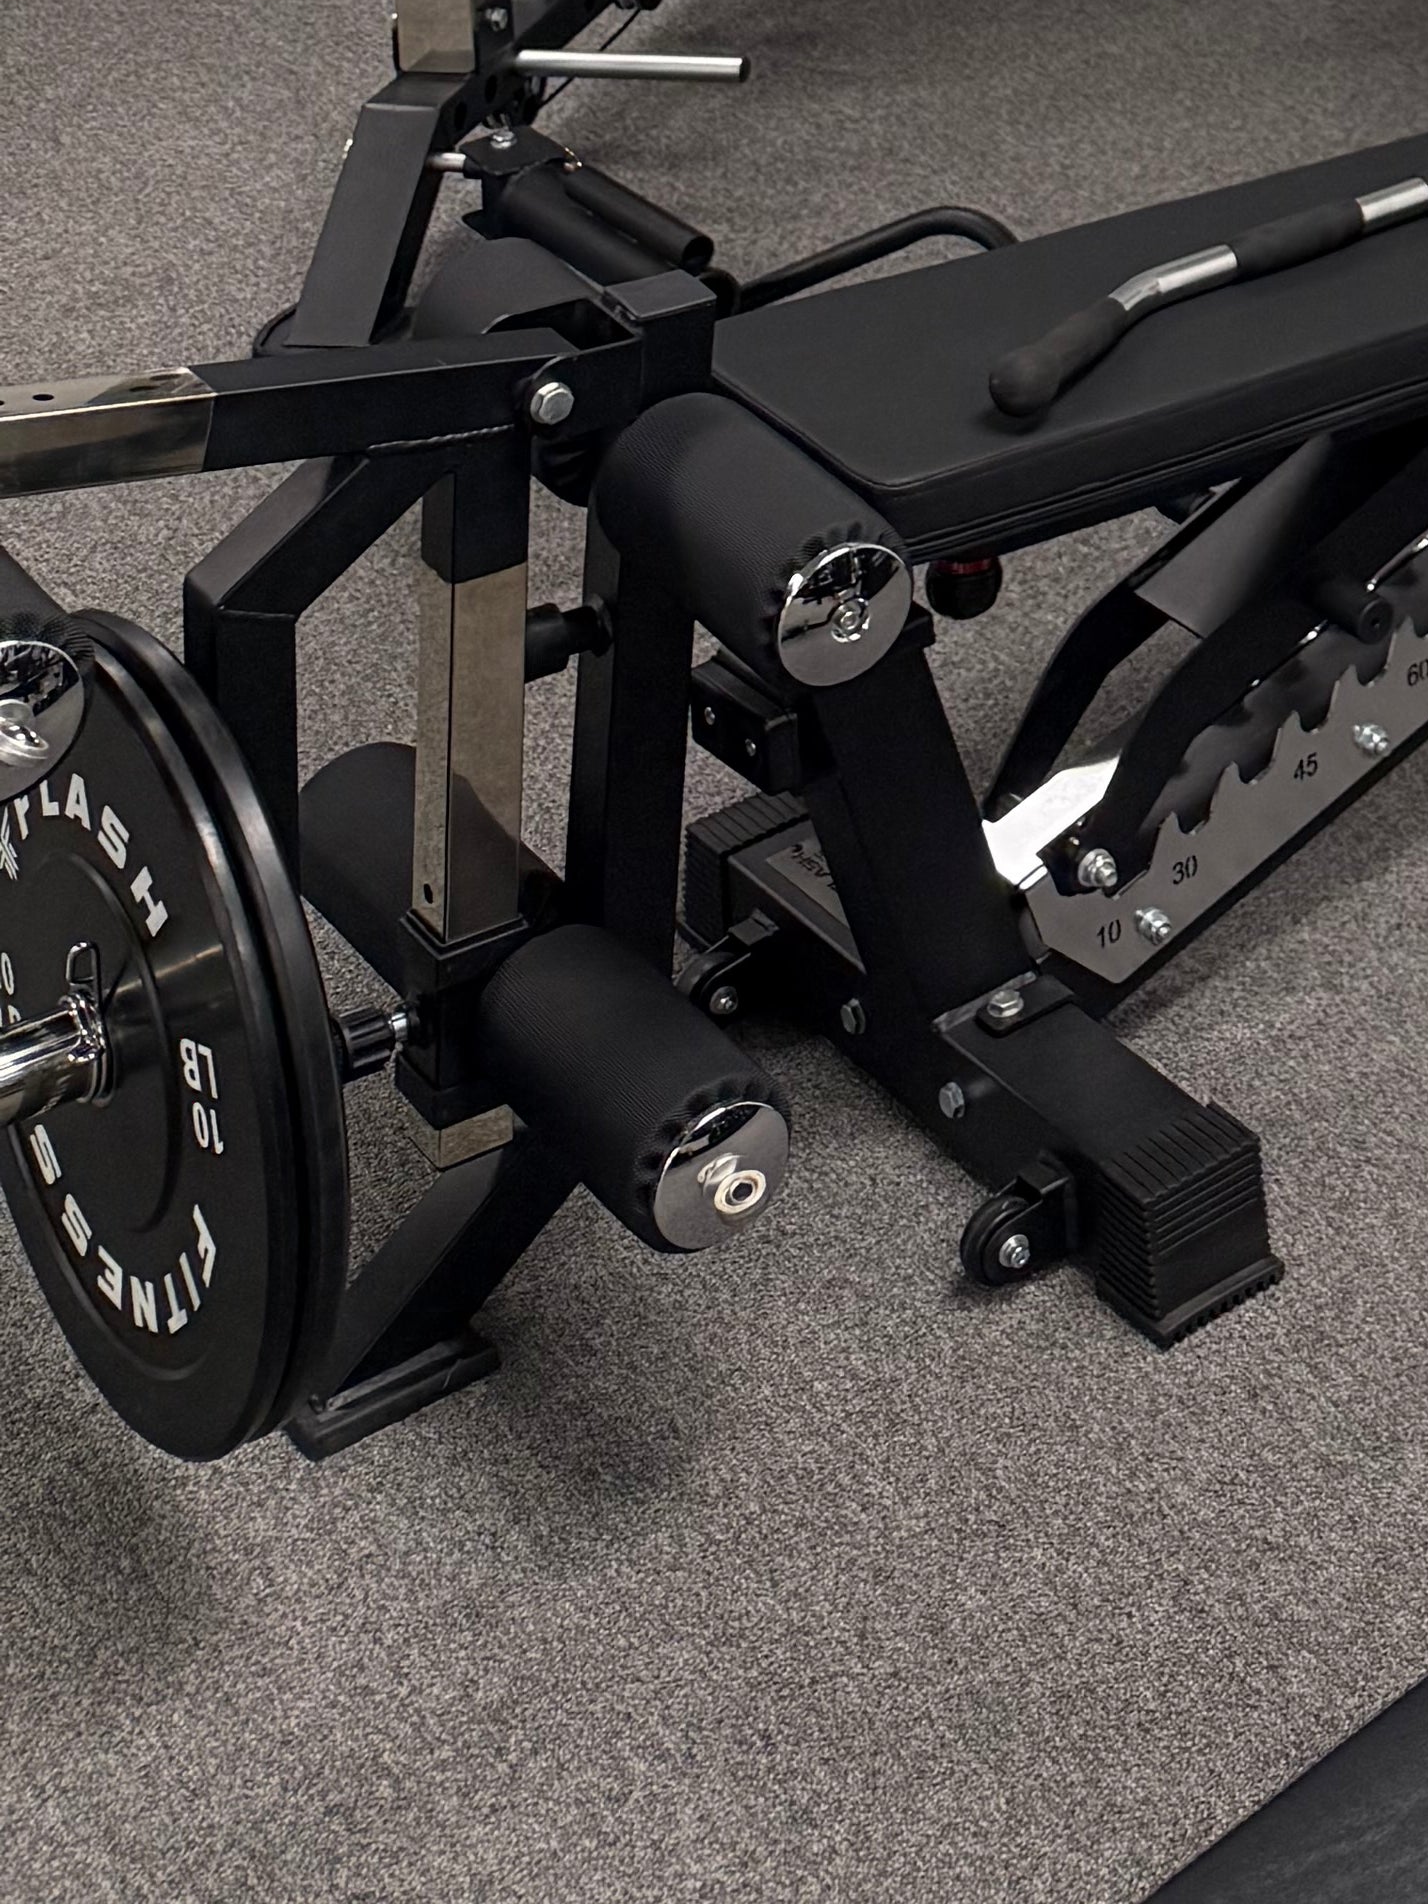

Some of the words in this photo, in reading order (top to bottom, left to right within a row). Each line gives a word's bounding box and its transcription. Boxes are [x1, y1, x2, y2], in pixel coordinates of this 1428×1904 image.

[1292, 752, 1320, 784] 45
[13, 772, 169, 937] FLASH
[1171, 854, 1199, 888] 30
[1095, 919, 1122, 949] 10
[180, 1037, 219, 1099] LB
[192, 1101, 224, 1155] 10
[30, 1124, 217, 1335] FITNESS
